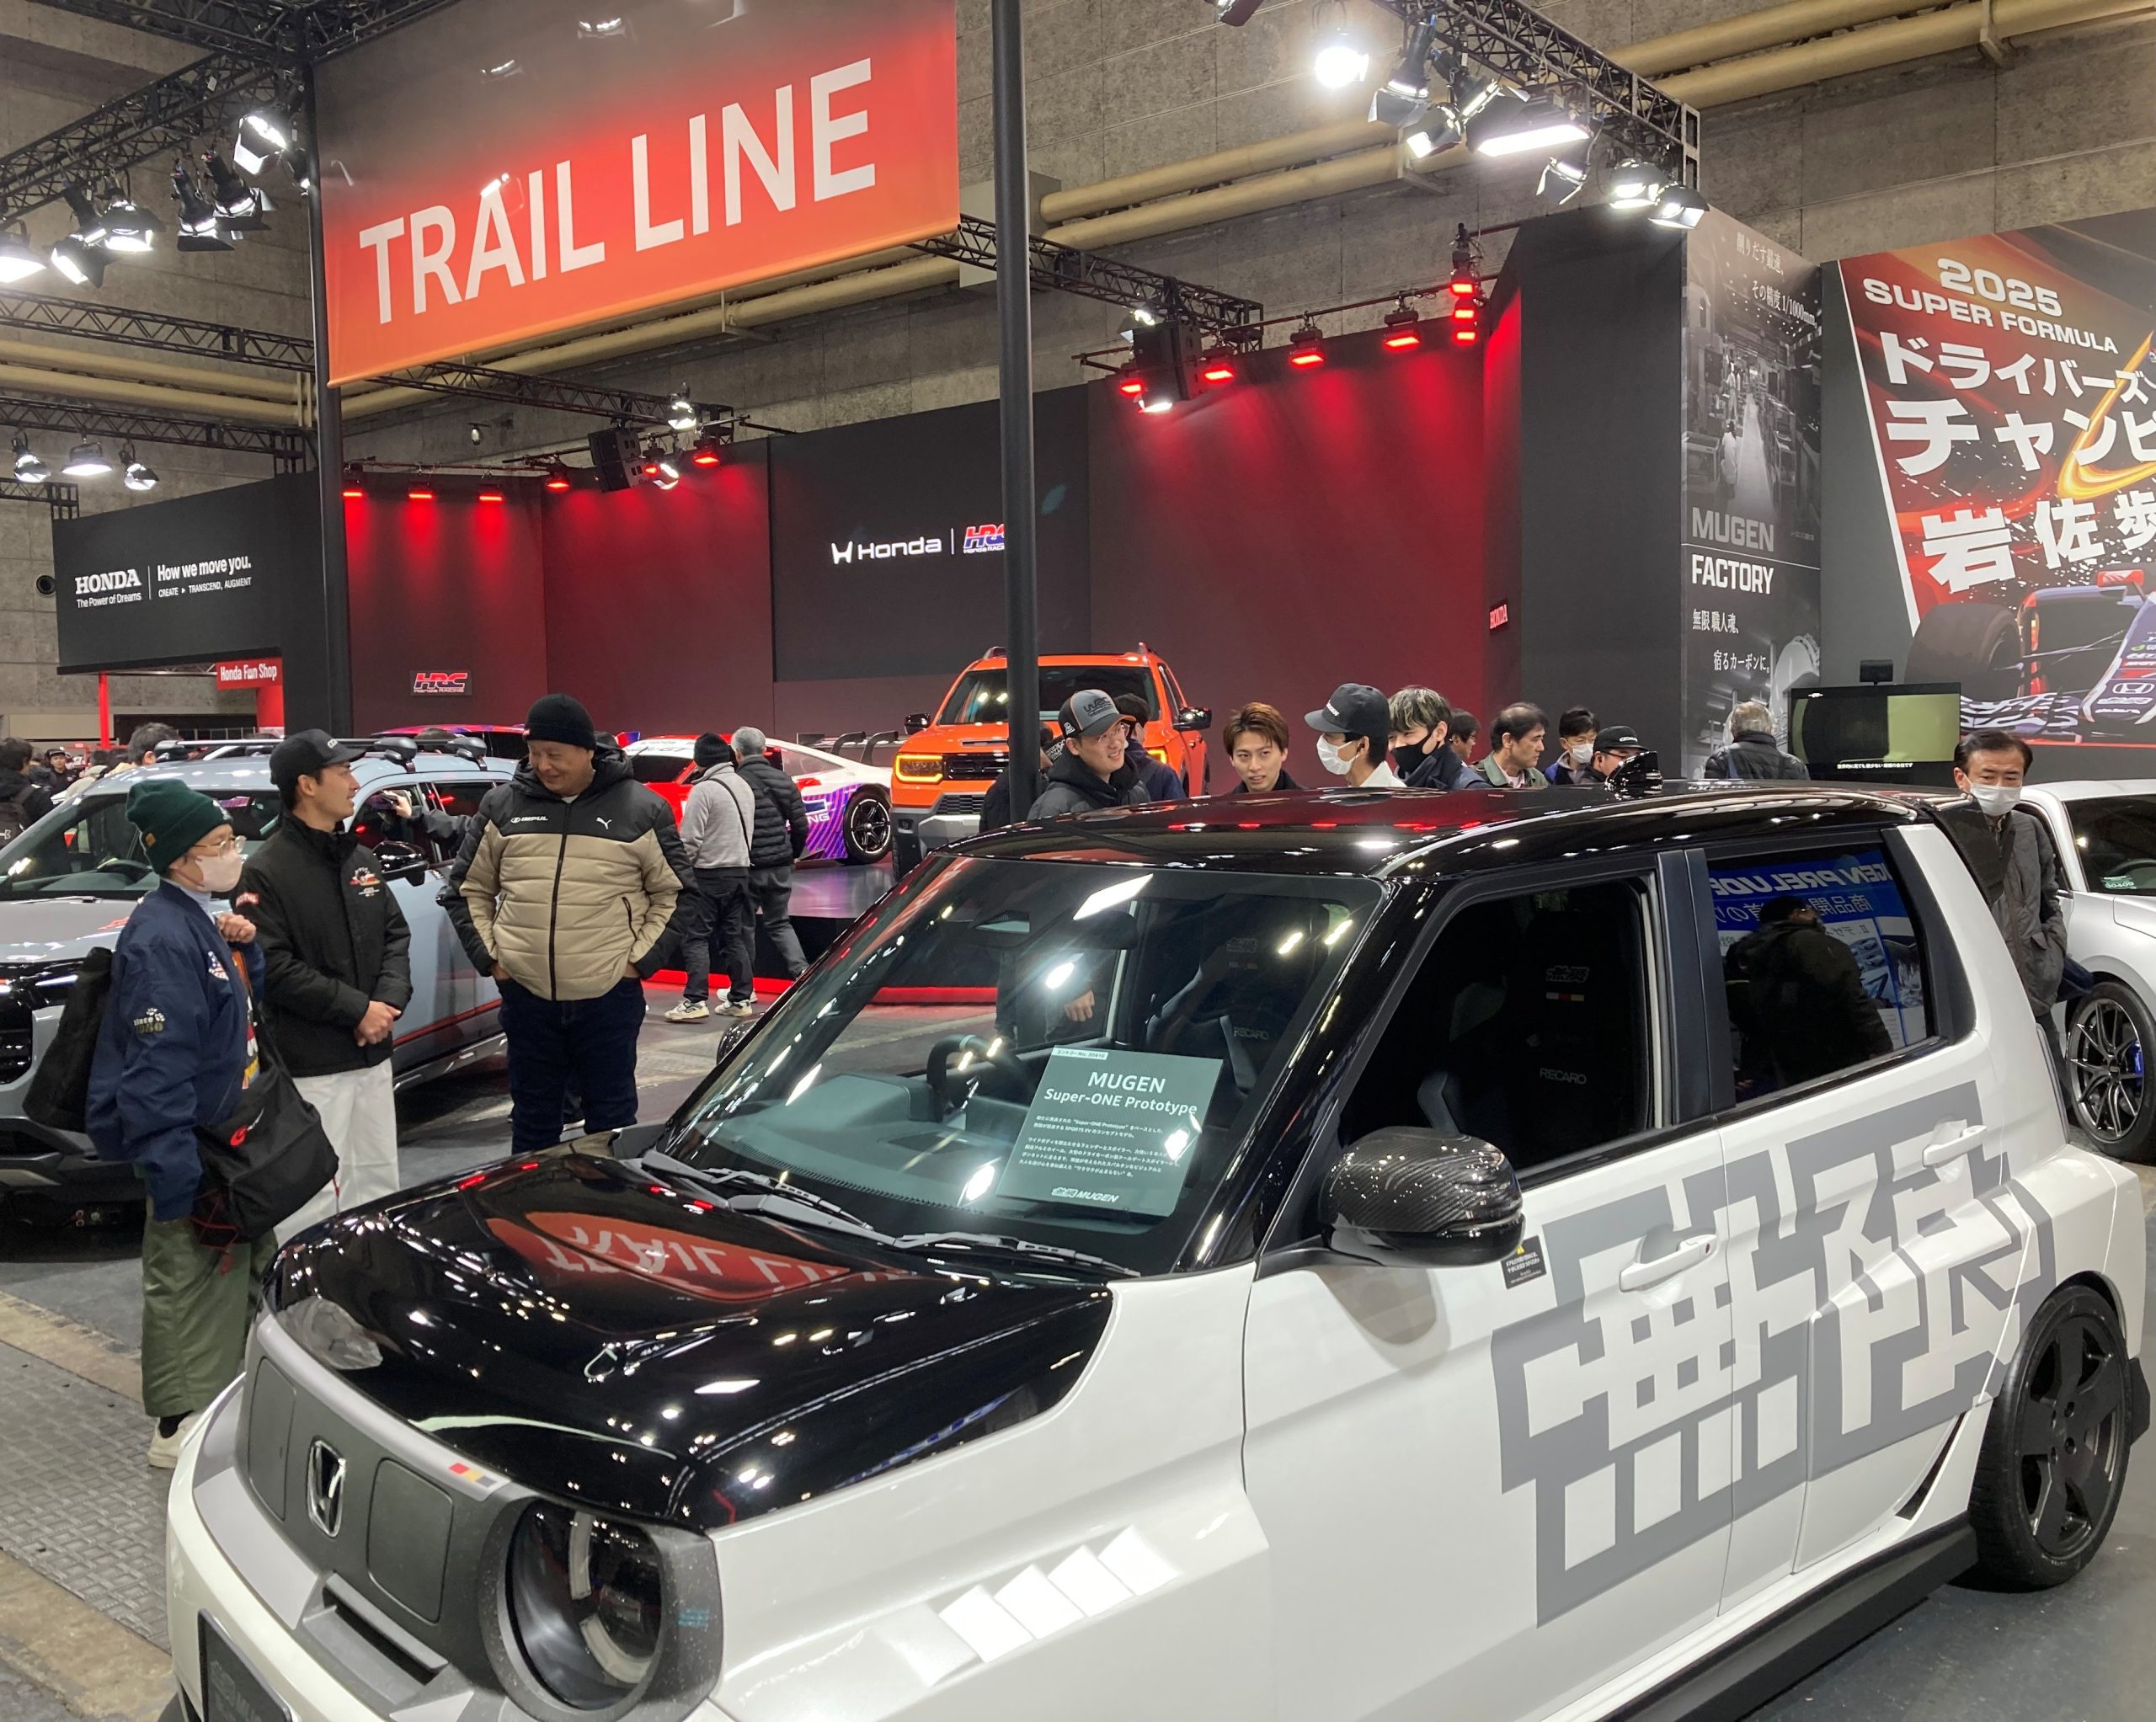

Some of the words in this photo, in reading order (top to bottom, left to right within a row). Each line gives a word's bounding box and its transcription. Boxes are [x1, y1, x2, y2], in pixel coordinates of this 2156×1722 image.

[359, 160, 605, 323] TRAIL
[632, 57, 876, 252] LINE
[1937, 258, 2063, 317] 2025
[1862, 278, 1994, 328] SUPER
[1999, 310, 2119, 355] FORMULA
[1879, 331, 2151, 405] ドライバーズ
[1692, 507, 1774, 552] MUGEN
[857, 536, 942, 561] Honda
[157, 563, 180, 581] How
[182, 564, 197, 578] we
[199, 559, 227, 575] move
[228, 556, 252, 575] you.
[1692, 554, 1774, 594] FACTORY
[75, 569, 141, 594] HONDA
[158, 587, 179, 598] CREATE
[189, 581, 223, 594] TRANSCEND,
[224, 577, 252, 589] AUGMENT
[77, 599, 88, 608] The
[88, 596, 109, 607] Power
[109, 594, 116, 604] of
[117, 592, 141, 604] Dreams
[220, 665, 243, 681] Honda
[259, 663, 277, 681] Shop
[414, 673, 468, 690] HRC
[1087, 1071, 1166, 1094] MUGEN
[1540, 1068, 1587, 1085] RECARO
[1043, 1088, 1122, 1107] Super-ONE
[1124, 1096, 1198, 1116] Prototype
[1076, 1191, 1119, 1203] MUGEN
